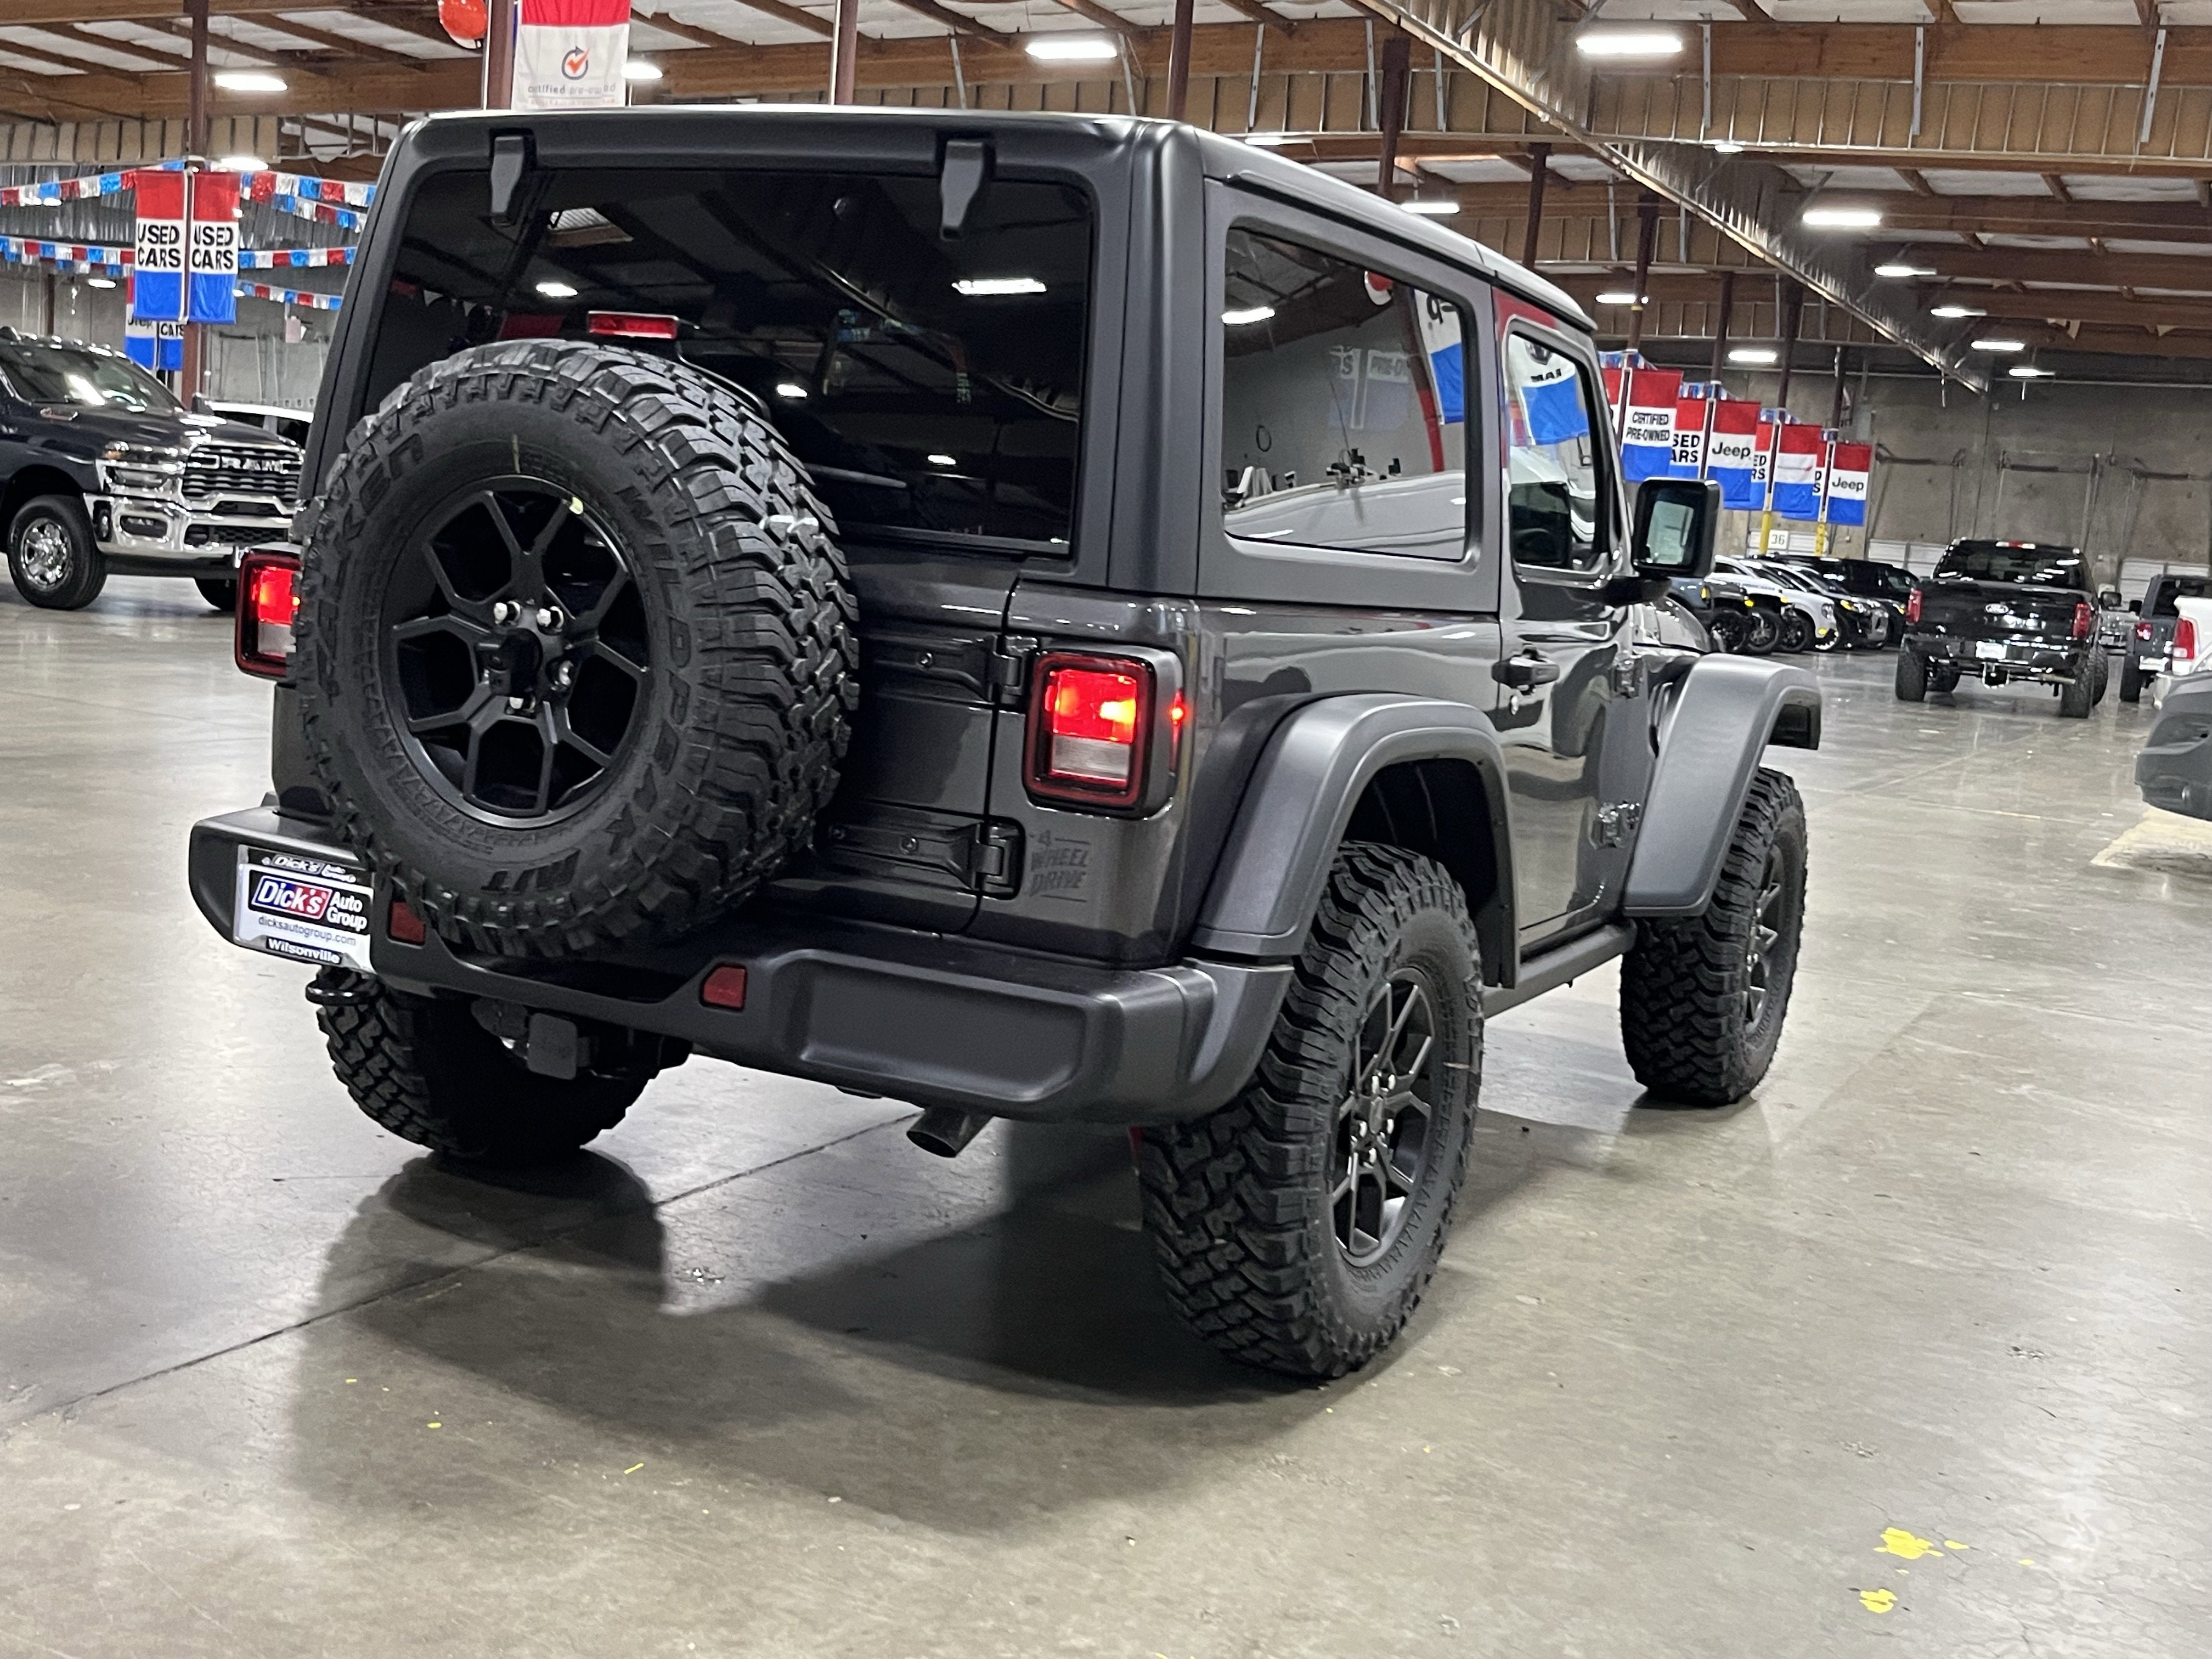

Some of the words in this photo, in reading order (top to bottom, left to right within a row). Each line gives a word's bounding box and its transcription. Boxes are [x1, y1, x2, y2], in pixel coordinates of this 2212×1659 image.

[138, 223, 180, 245] USED
[194, 225, 234, 246] USED
[138, 246, 181, 268] CARS
[191, 249, 234, 269] CARS
[1632, 412, 1669, 425] CERTIFIED
[1626, 427, 1671, 442] PRE-OWNED
[1672, 434, 1701, 448] SED
[1671, 449, 1698, 463] ARS
[1712, 442, 1751, 459] Jeep
[1753, 455, 1767, 466] ED
[1832, 477, 1864, 492] Jeep
[1771, 534, 1785, 545] 36
[1031, 848, 1088, 872] WHEEL
[257, 880, 325, 914] Dick's
[330, 891, 363, 913] Auto
[326, 906, 368, 932] Group
[258, 916, 357, 946] dicksautogroup.com
[268, 938, 340, 964] Wilsonville
